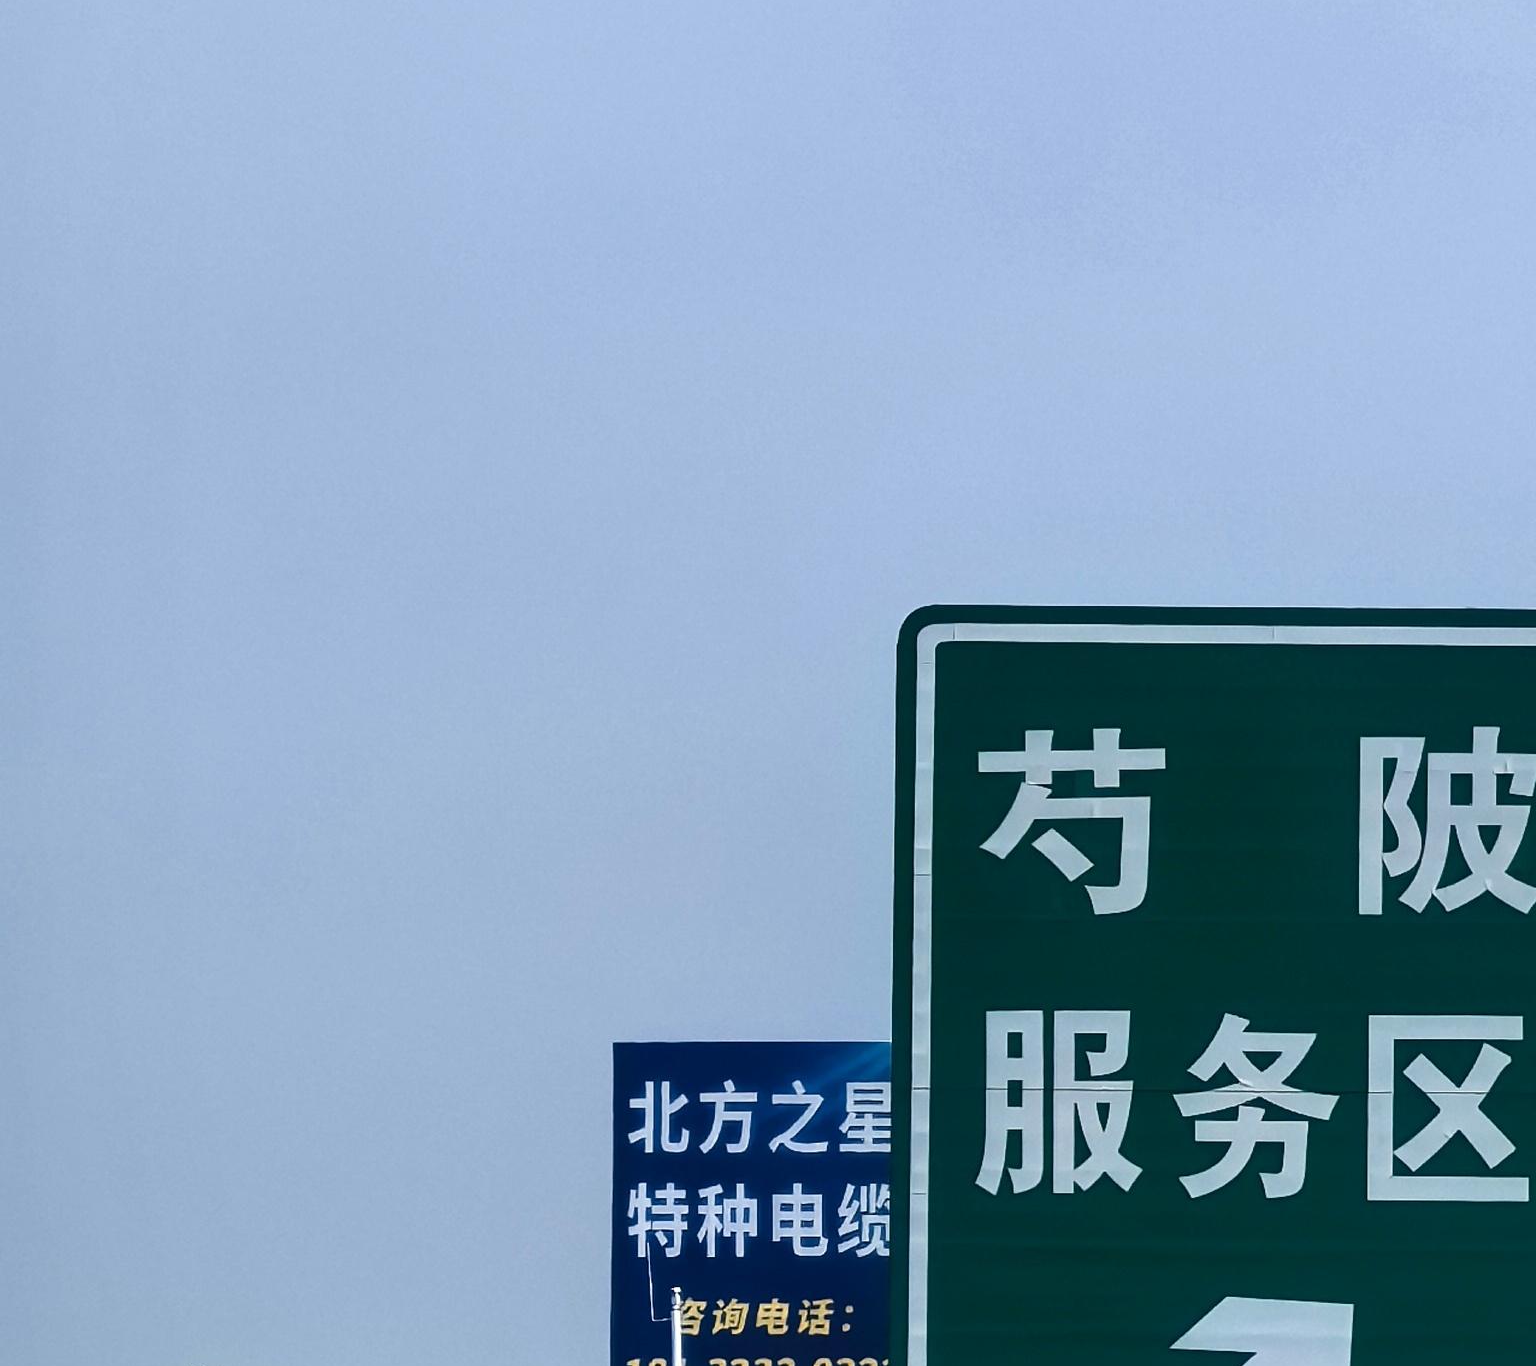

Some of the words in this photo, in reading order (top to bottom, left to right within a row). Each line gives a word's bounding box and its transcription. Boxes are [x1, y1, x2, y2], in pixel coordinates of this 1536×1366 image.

[627, 1079, 892, 1155] 北方之星
[975, 1009, 1531, 1203] 服务区
[627, 1182, 891, 1258] 特种电缆
